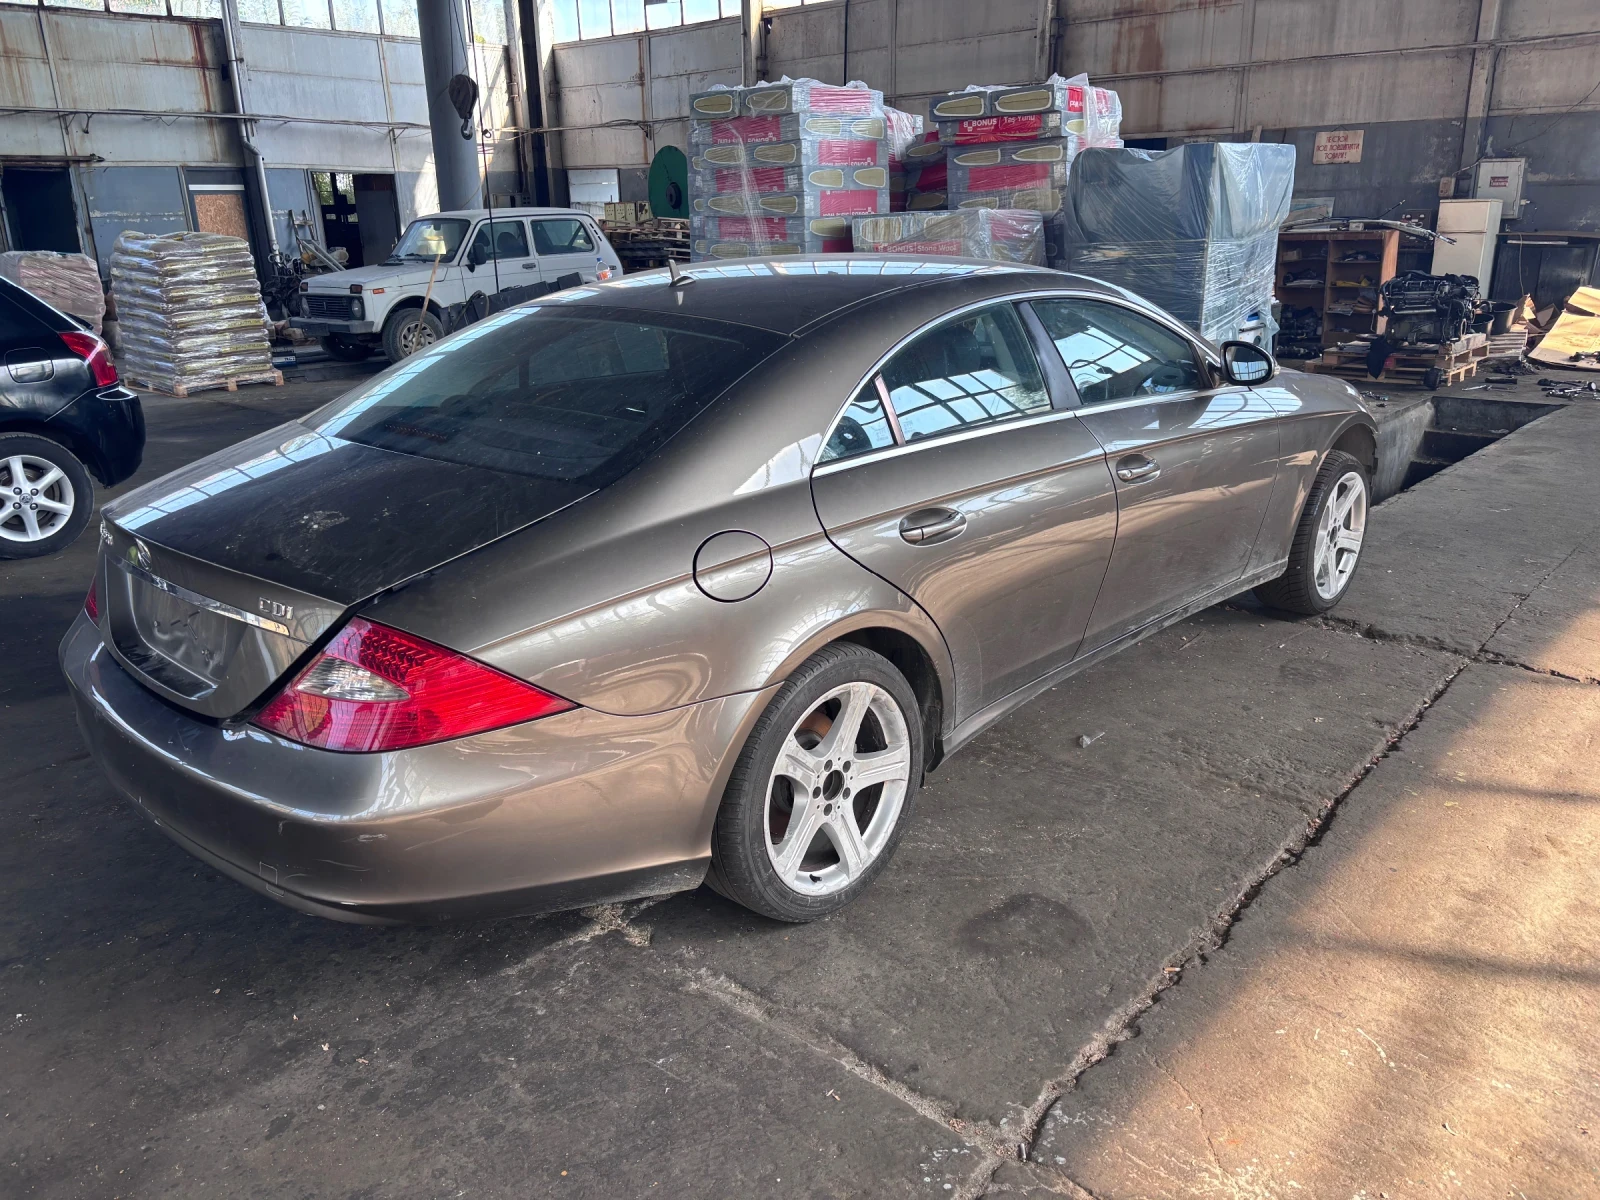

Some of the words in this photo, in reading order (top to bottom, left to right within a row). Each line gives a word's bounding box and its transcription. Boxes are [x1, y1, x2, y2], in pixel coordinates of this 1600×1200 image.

[972, 117, 998, 127] BONUS
[887, 245, 914, 253] BONUS
[938, 244, 957, 252] Wool
[259, 597, 294, 620] CDI
